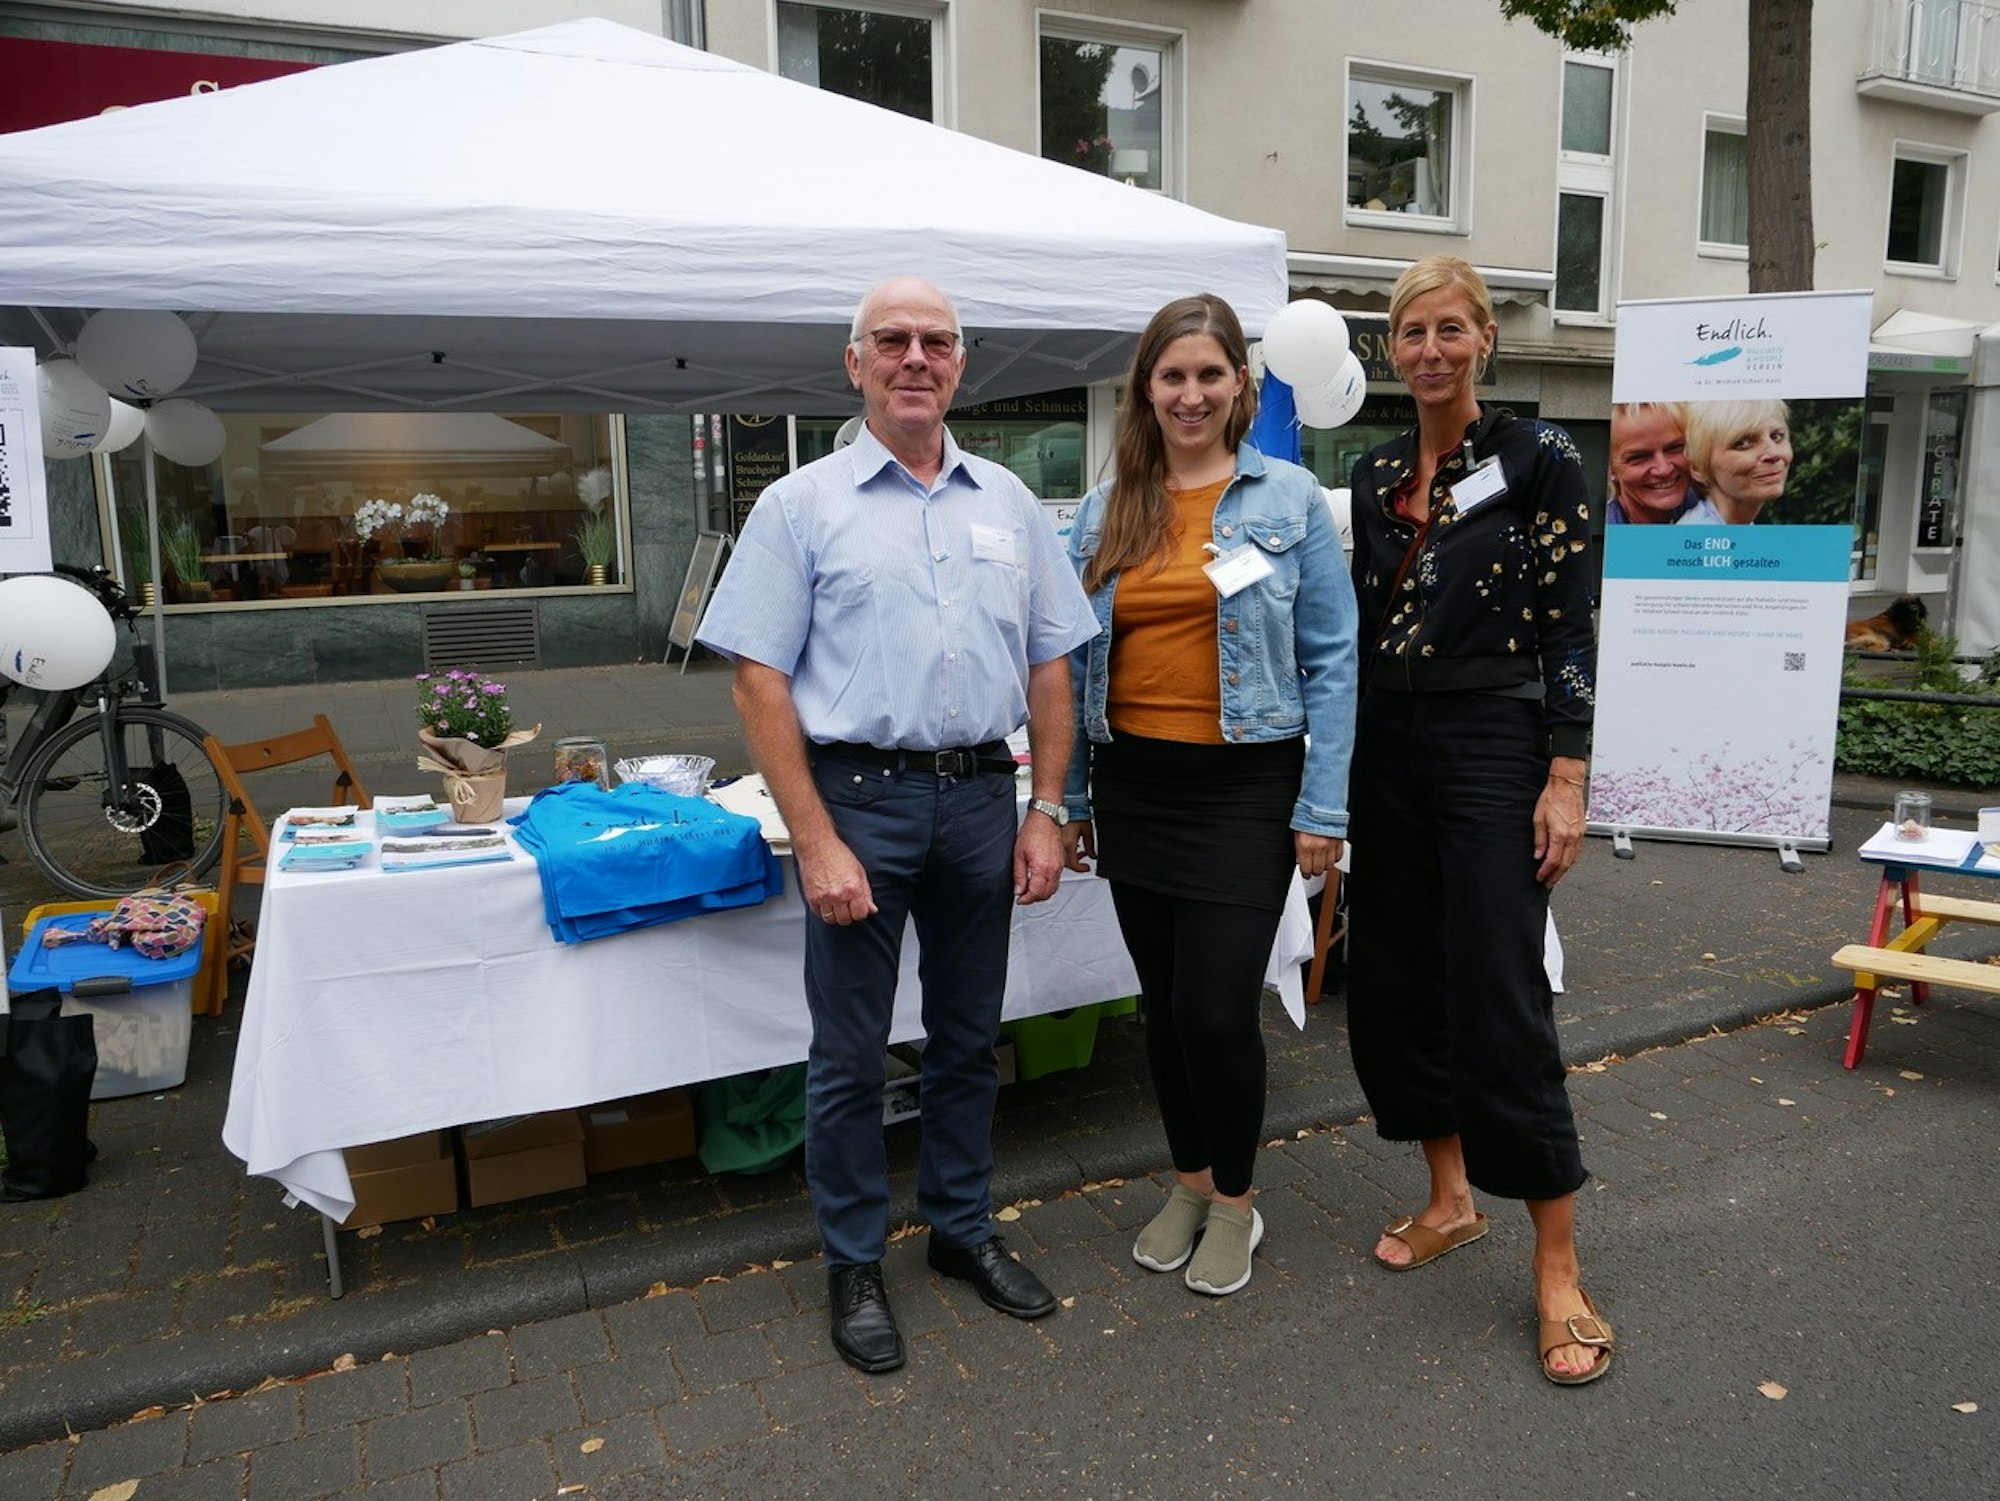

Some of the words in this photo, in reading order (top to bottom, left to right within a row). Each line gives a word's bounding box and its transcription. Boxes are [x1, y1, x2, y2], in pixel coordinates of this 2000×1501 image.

[1696, 317, 1772, 341] Endlich.
[994, 400, 1019, 412] und
[1025, 400, 1086, 413] Schmuck
[735, 452, 785, 462] Goldankauf
[1684, 539, 1702, 550] Das
[1704, 537, 1736, 550] ENDe
[1733, 557, 1780, 570] gestalten
